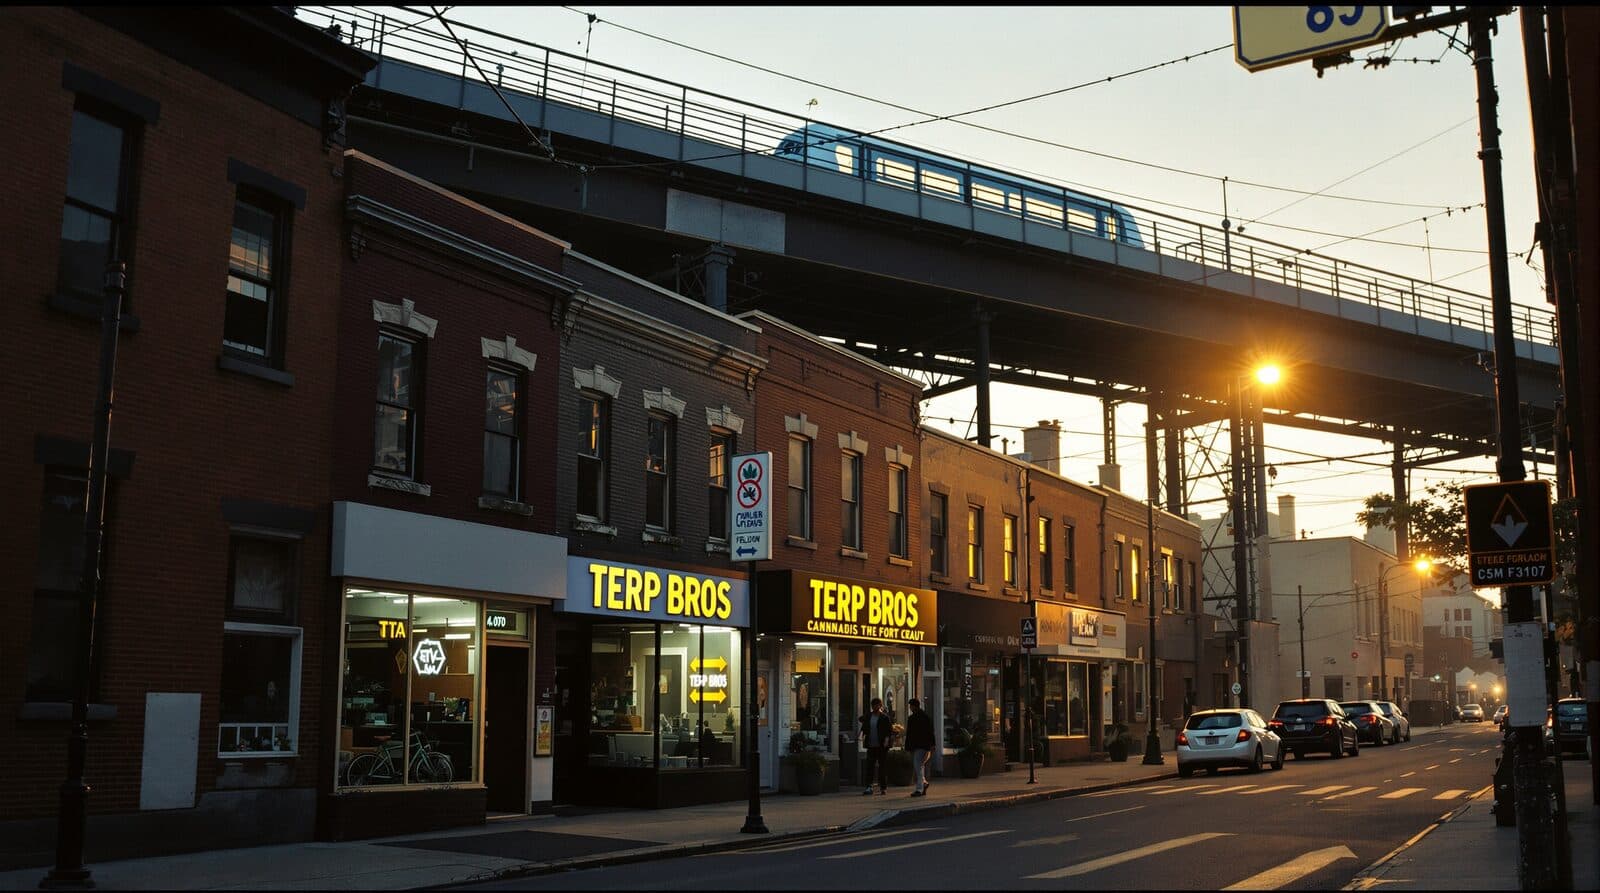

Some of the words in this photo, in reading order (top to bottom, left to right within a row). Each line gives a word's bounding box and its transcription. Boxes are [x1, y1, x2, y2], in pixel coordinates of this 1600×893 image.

[589, 564, 662, 612] TERP
[667, 573, 732, 620] BROS
[810, 579, 866, 622] TERP
[868, 587, 919, 628] BROS
[378, 620, 406, 639] TTA
[861, 625, 877, 637] THE
[879, 626, 899, 639] FORT
